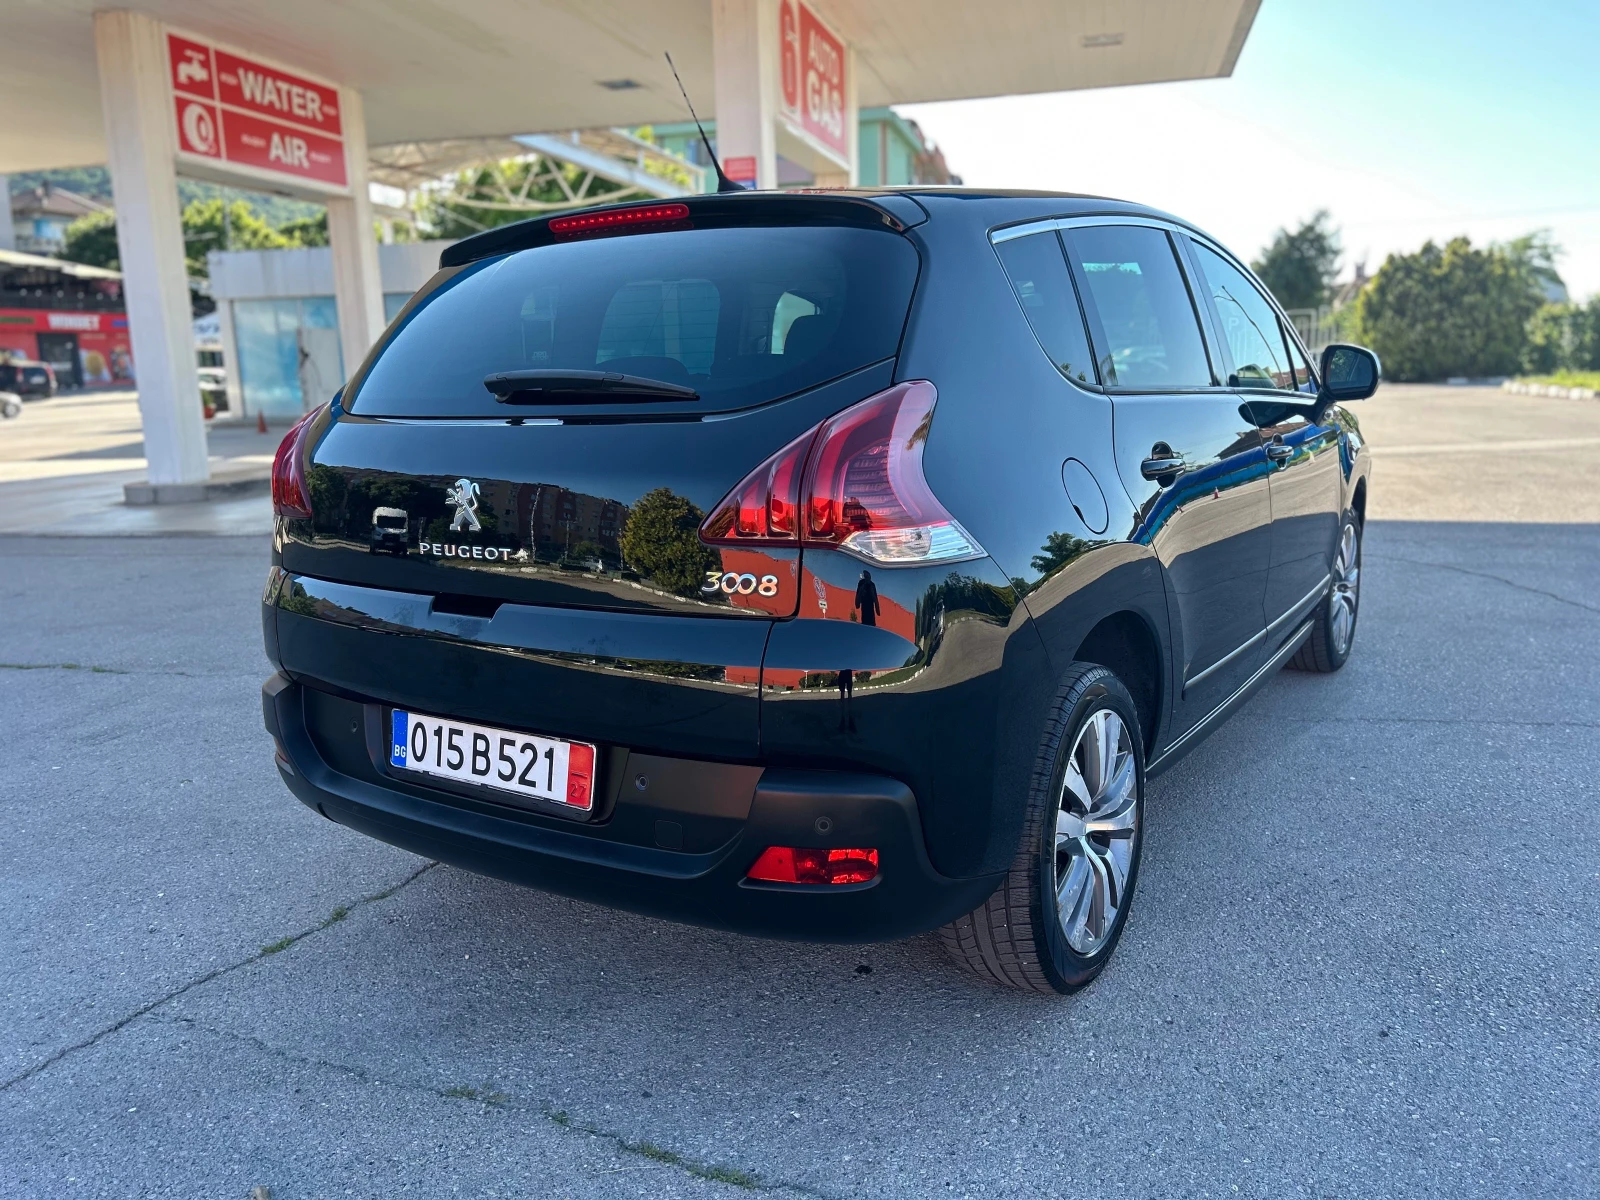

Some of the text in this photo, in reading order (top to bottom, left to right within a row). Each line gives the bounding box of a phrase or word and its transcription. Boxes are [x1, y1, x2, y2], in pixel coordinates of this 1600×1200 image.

[808, 28, 839, 85] AUTO
[237, 67, 323, 122] WATER
[806, 69, 842, 139] GAS
[269, 132, 309, 169] AIR
[419, 542, 511, 561] PEUGEOT
[701, 571, 778, 597] 3008
[394, 744, 407, 758] BG
[570, 782, 587, 798] 27
